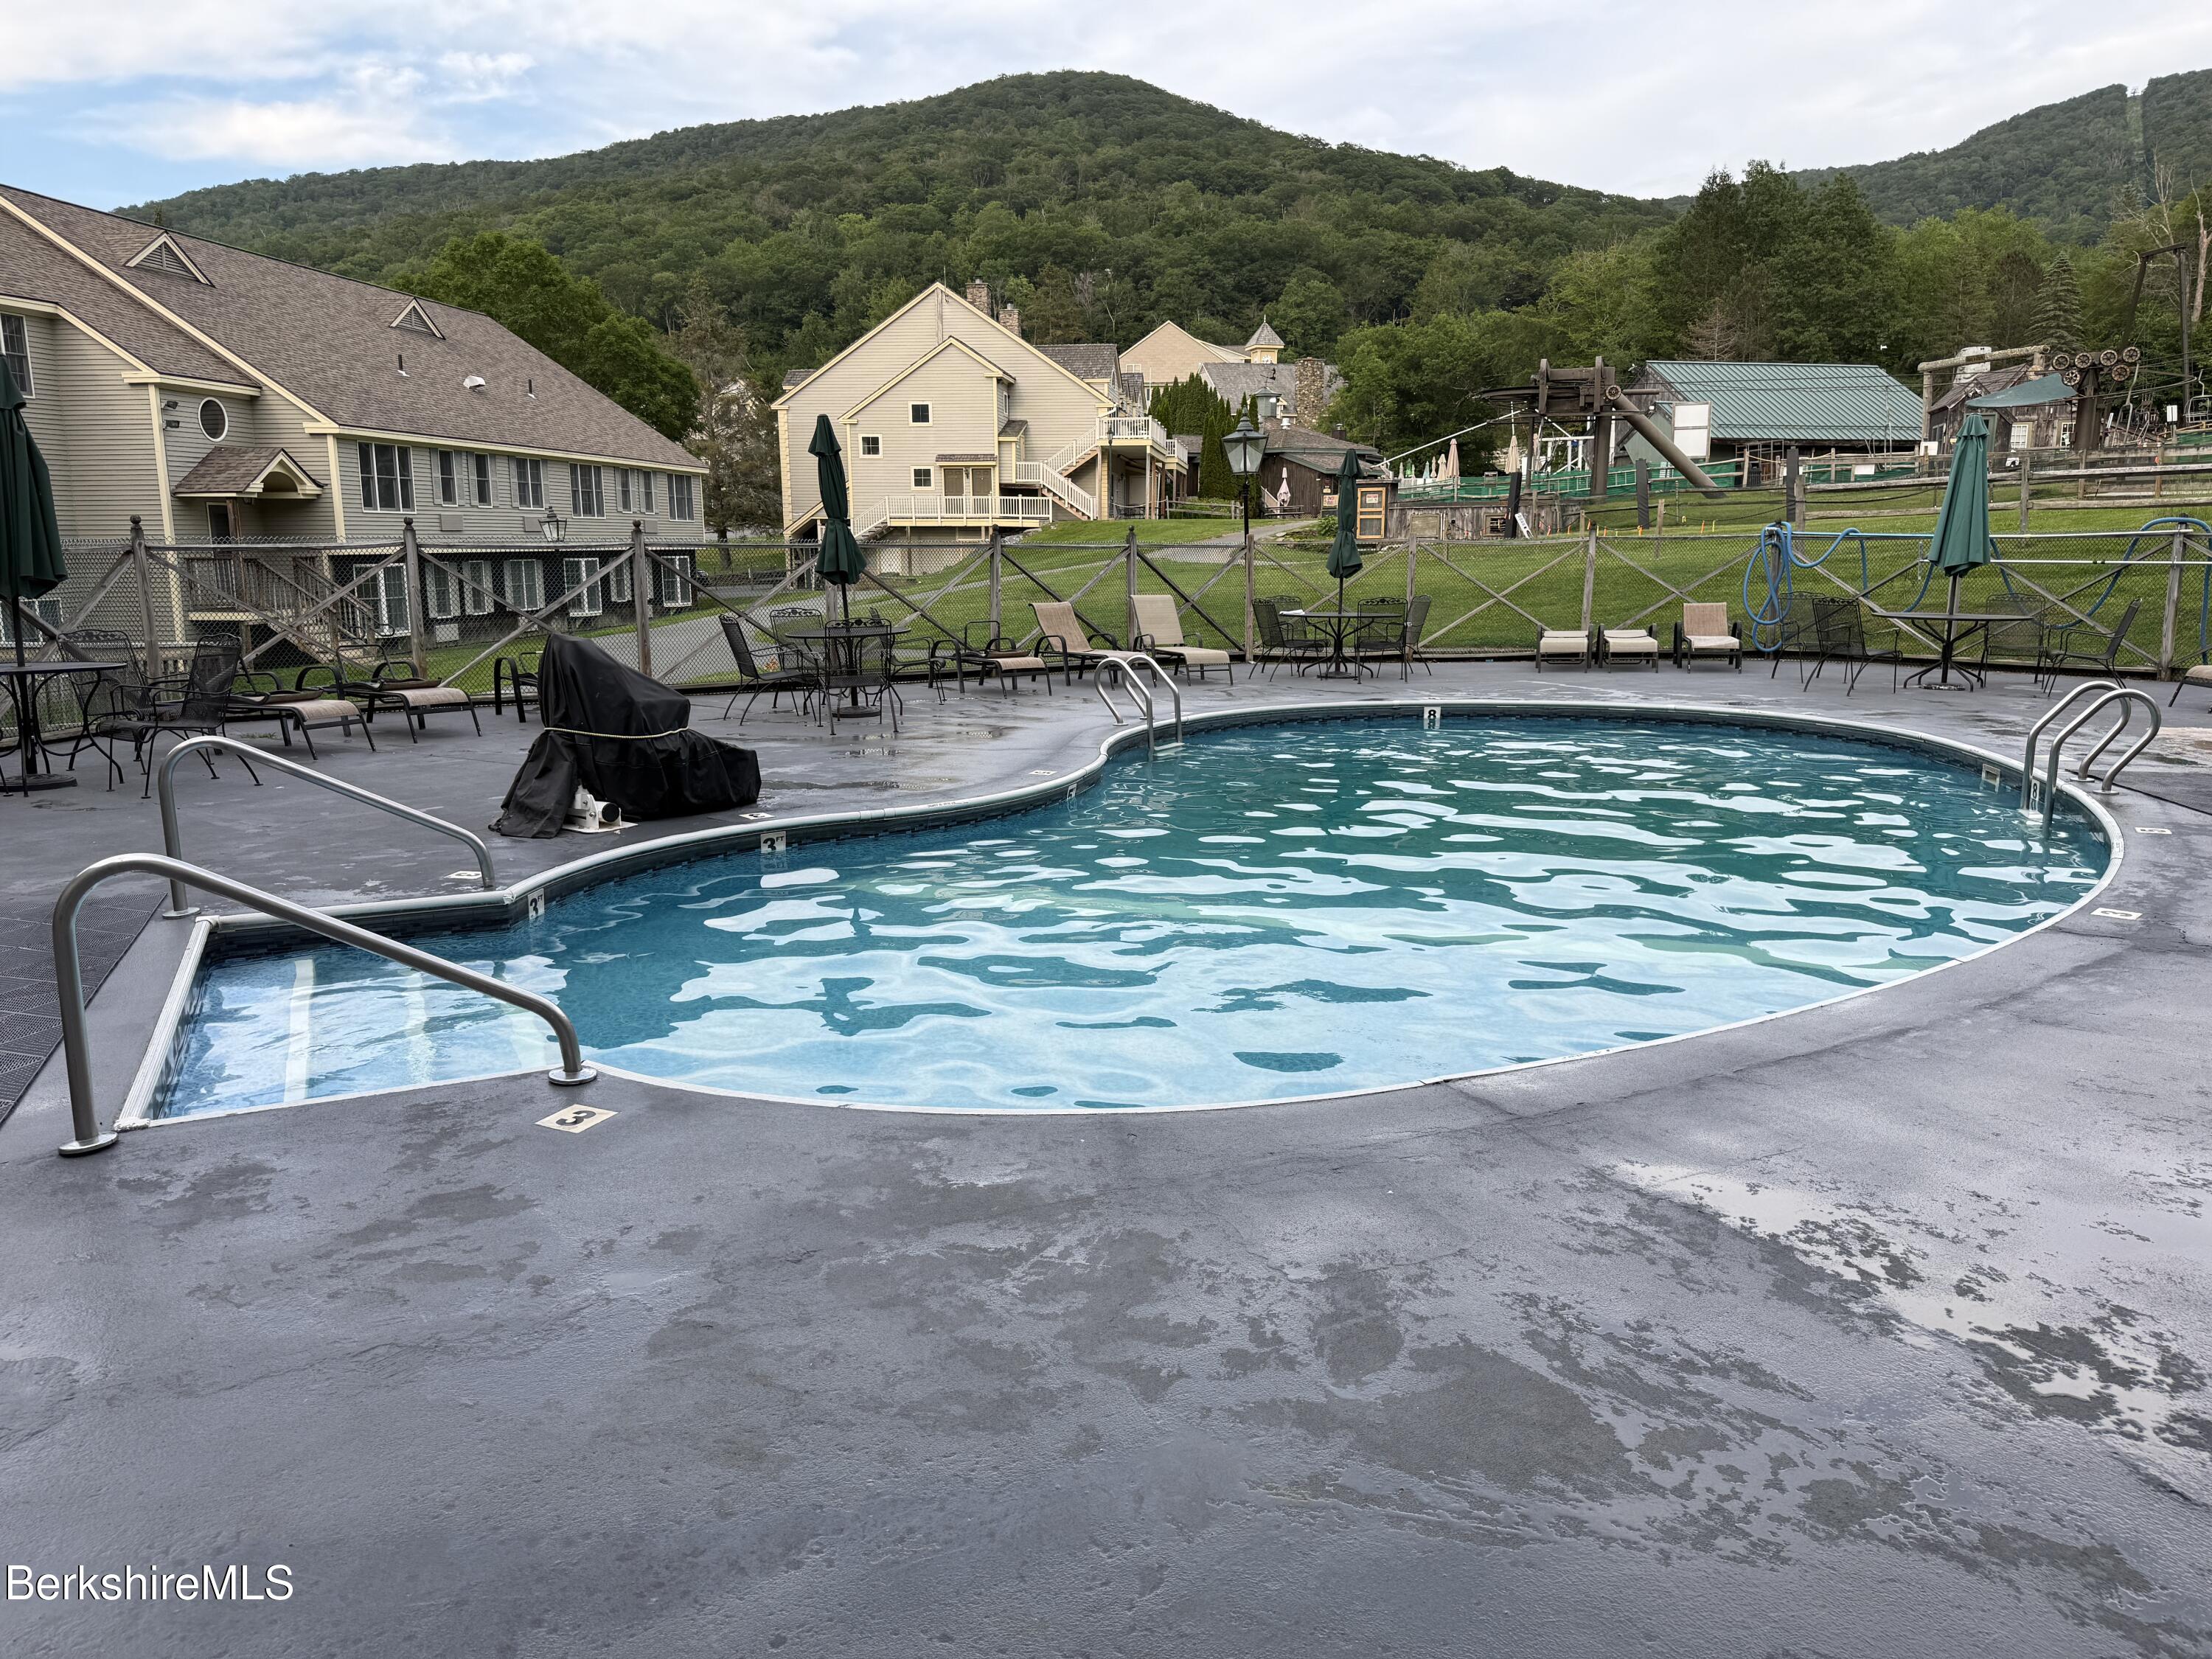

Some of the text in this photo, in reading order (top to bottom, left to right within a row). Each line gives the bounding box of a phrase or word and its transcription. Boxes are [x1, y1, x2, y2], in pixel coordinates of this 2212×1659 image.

[1427, 709, 1436, 720] 8
[2033, 782, 2037, 799] 8
[555, 1110, 597, 1126] 3
